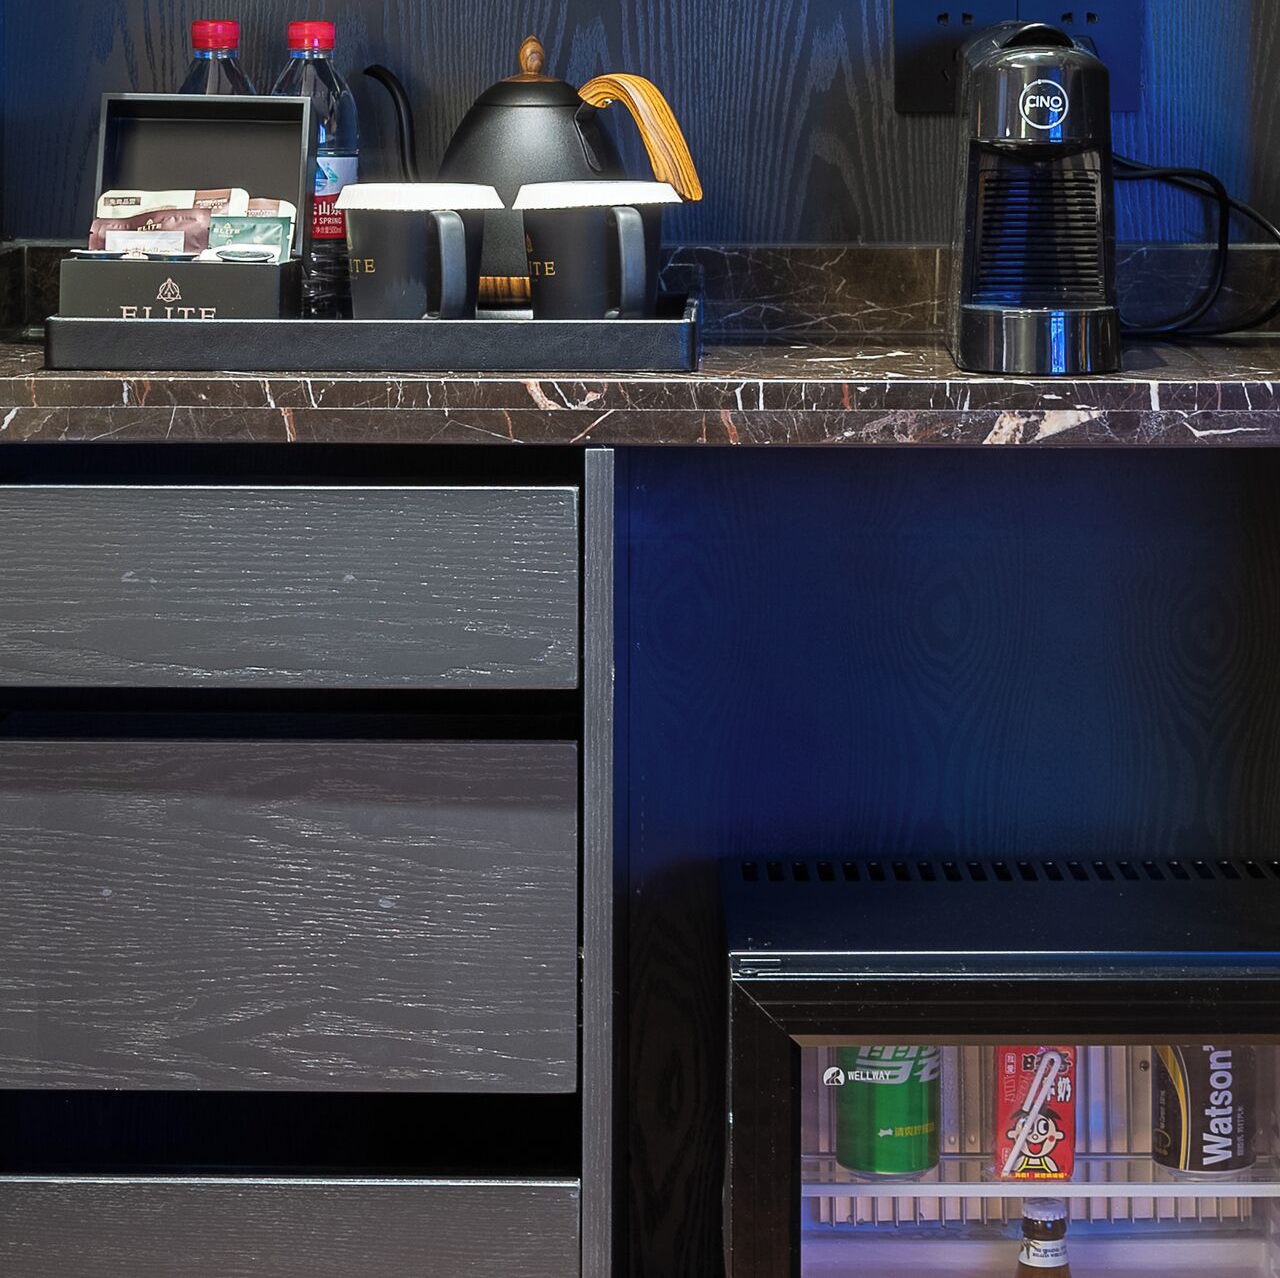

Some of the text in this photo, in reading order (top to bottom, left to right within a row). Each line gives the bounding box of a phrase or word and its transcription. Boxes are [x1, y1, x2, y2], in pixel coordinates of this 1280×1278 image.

[320, 217, 342, 225] SPRING
[120, 305, 217, 319] ELITE
[848, 1070, 891, 1081] WELLWAY
